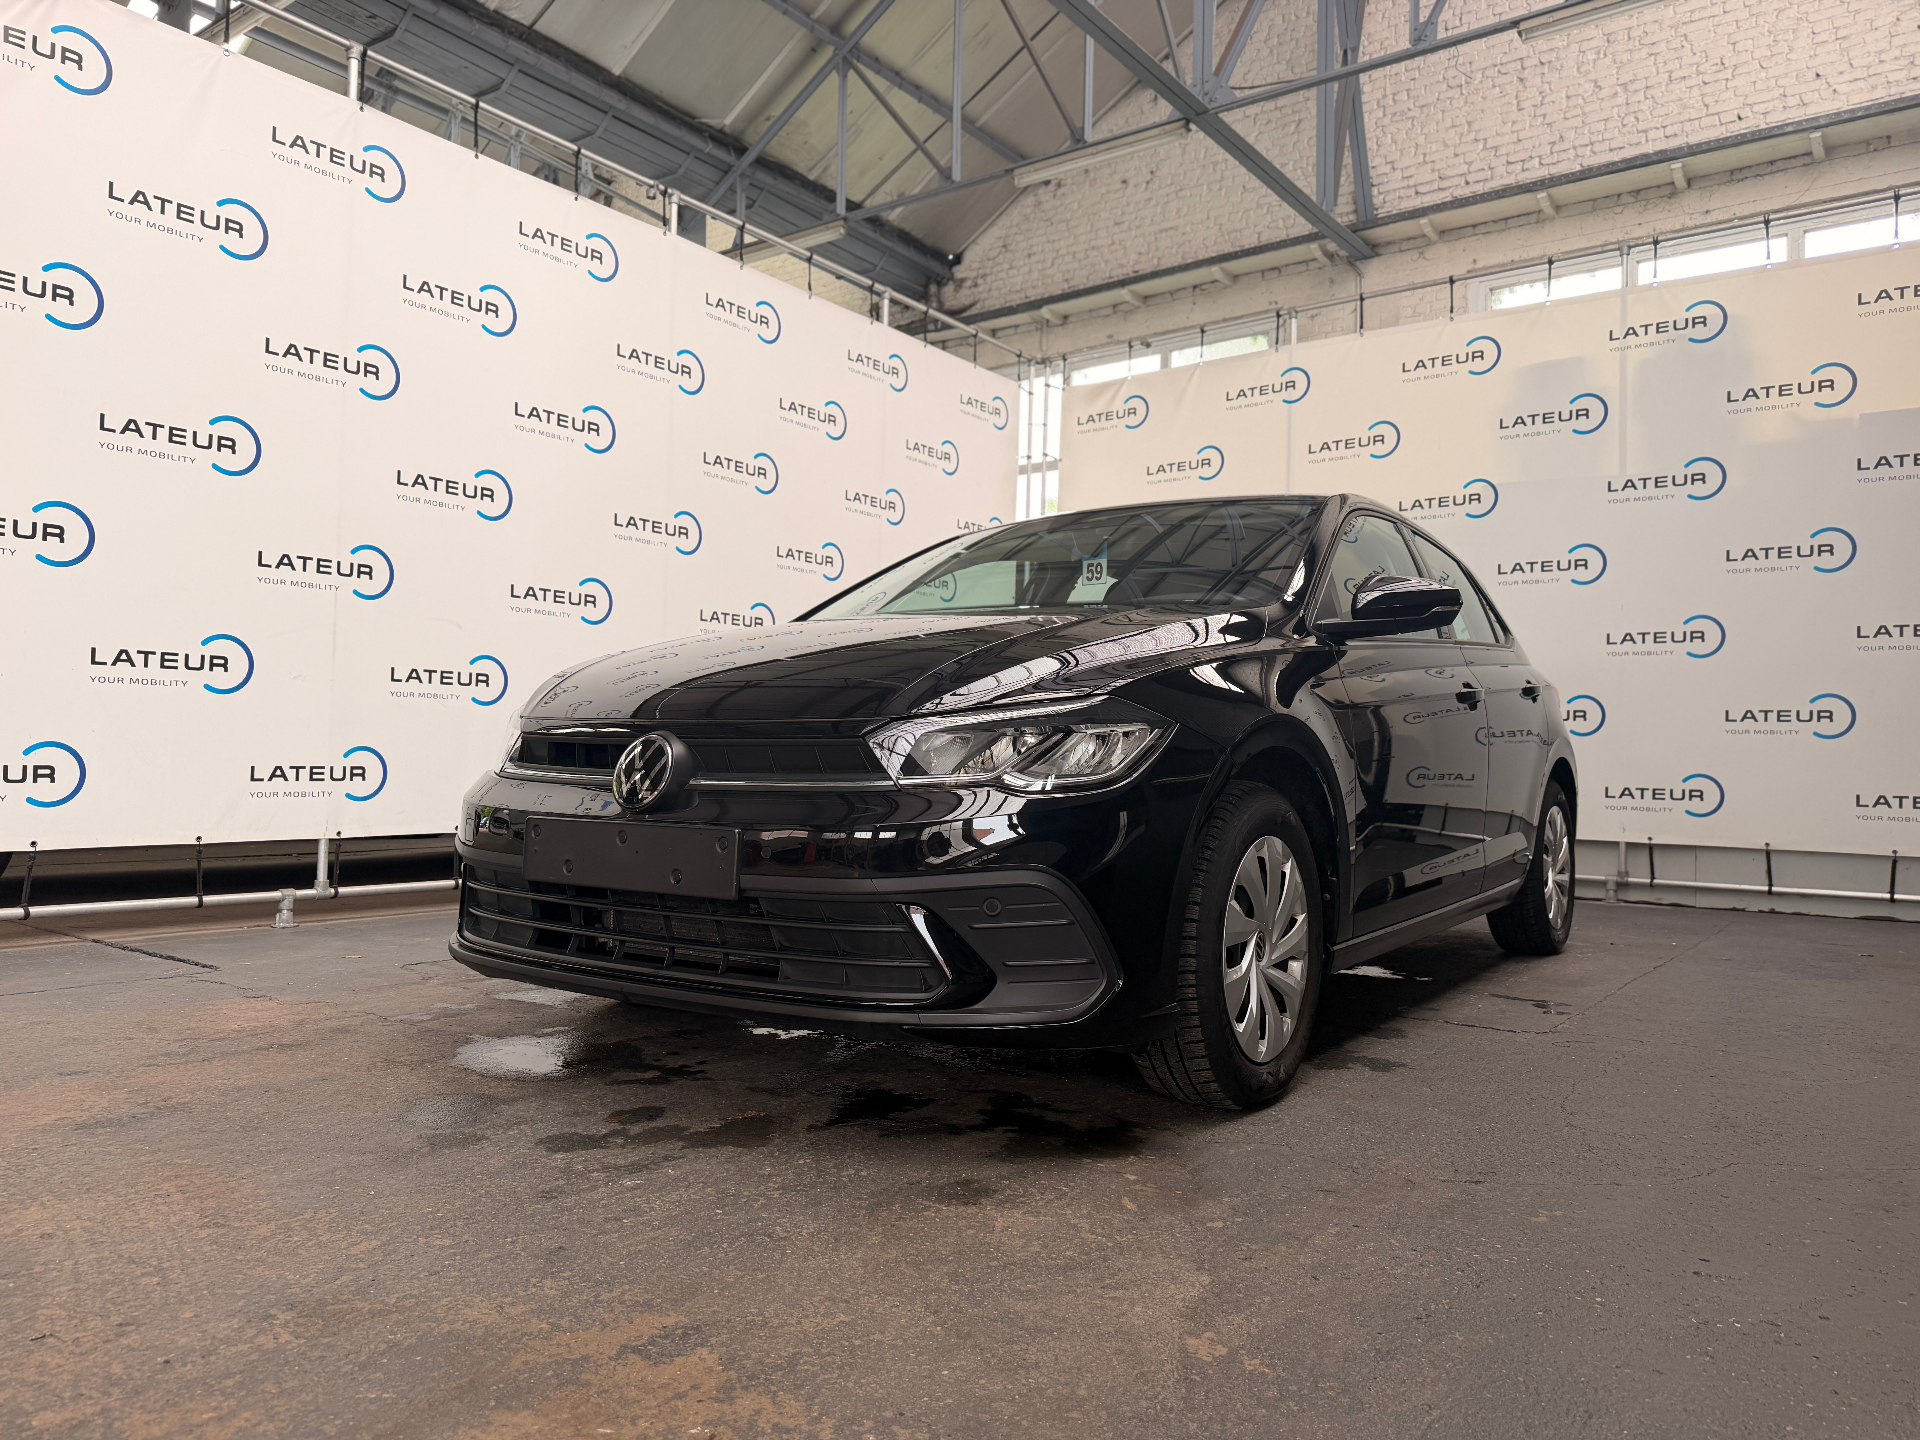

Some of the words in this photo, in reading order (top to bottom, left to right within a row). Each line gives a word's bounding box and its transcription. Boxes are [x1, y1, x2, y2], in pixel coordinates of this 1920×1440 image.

[3, 25, 83, 71] EUR
[3, 54, 35, 71] ILITY
[272, 126, 385, 183] LATEUR
[272, 152, 300, 166] YOUR
[304, 164, 352, 184] MOBILITY
[108, 181, 243, 239] LATEUR
[108, 209, 141, 225] YOUR
[147, 221, 203, 242] MOBILITY
[519, 221, 602, 265] LATEUR
[519, 243, 539, 255] YOUR
[543, 252, 578, 268] MOBILITY
[0, 270, 74, 306] EUR
[403, 274, 499, 318] LATEUR
[1858, 284, 1920, 305] LAT
[403, 298, 426, 310] YOUR
[430, 307, 470, 323] MOBILITY
[706, 293, 769, 328] LATEUR
[1858, 309, 1884, 319] YOUR
[1889, 304, 1920, 314] MOBIL
[706, 312, 721, 322] YOUR
[723, 319, 750, 332] MOBILITY
[1609, 316, 1707, 341] LATEUR
[1609, 344, 1631, 353] YOUR
[1635, 338, 1676, 348] MOBILITY
[265, 337, 379, 380] LATEUR
[617, 344, 691, 379] LATEUR
[848, 350, 899, 378] LATEUR
[1402, 350, 1484, 373] LATEUR
[265, 363, 293, 375] YOUR
[298, 371, 346, 387] MOBILITY
[617, 364, 635, 374] YOUR
[638, 371, 670, 383] MOBILITY
[1402, 376, 1421, 384] YOUR
[1424, 370, 1458, 381] MOBILITY
[1226, 380, 1295, 401] LATEUR
[1727, 379, 1834, 403] LATEUR
[780, 398, 836, 426] LATEUR
[960, 394, 1001, 418] LATEUR
[1226, 404, 1242, 412] YOUR
[1244, 399, 1274, 409] MOBILITY
[1727, 407, 1751, 415] YOUR
[1756, 401, 1801, 412] MOBILITY
[515, 402, 599, 436] LATEUR
[1078, 407, 1136, 425] LATEUR
[1500, 408, 1589, 429] LATEUR
[100, 413, 236, 454] LATEUR
[514, 424, 535, 434] YOUR
[539, 430, 574, 443] MOBILITY
[1500, 433, 1520, 441] YOUR
[1523, 428, 1561, 438] MOBILITY
[99, 442, 132, 453] YOUR
[138, 449, 196, 464] MOBILITY
[906, 439, 950, 463] LATEUR
[1309, 435, 1384, 454] LATEUR
[704, 452, 766, 479] LATEUR
[1147, 458, 1211, 475] LATEUR
[1308, 457, 1326, 465] YOUR
[1328, 453, 1360, 463] MOBILITY
[1857, 453, 1920, 471] LAT
[397, 470, 494, 502] LATEUR
[703, 470, 719, 480] YOUR
[721, 476, 748, 486] MOBILITY
[1608, 473, 1706, 492] LATEUR
[1857, 476, 1884, 484] YOUR
[1889, 473, 1920, 482] MOBIL
[397, 493, 420, 504] YOUR
[424, 499, 465, 511] MOBILITY
[846, 490, 895, 512] LATEUR
[1399, 493, 1481, 512] LATEUR
[1608, 497, 1630, 505] YOUR
[1634, 493, 1675, 503] MOBILITY
[614, 513, 688, 539] LATEUR
[957, 519, 986, 533] LATE
[1420, 512, 1455, 521] MOBILITY
[614, 533, 632, 542] YOUR
[635, 537, 667, 548] MOBILITY
[777, 546, 833, 567] LATEUR
[1726, 544, 1834, 562] LATEUR
[258, 551, 373, 580] LATEUR
[1086, 562, 1103, 581] 59
[1498, 559, 1588, 575] LATEUR
[1726, 567, 1750, 575] YOUR
[1755, 565, 1800, 573] MOBILITY
[257, 576, 286, 586] YOUR
[291, 581, 339, 591] MOBILITY
[1522, 577, 1560, 585] MOBILITY
[511, 584, 596, 608] LATEUR
[510, 605, 531, 614] YOUR
[535, 608, 570, 619] MOBILITY
[700, 609, 764, 627] LATEUR
[1607, 631, 1705, 645] LATEUR
[1857, 624, 1920, 638] LAT
[91, 647, 228, 672] LATEUR
[90, 675, 124, 685] YOUR
[130, 677, 188, 688] MOBILITY
[391, 667, 489, 687] LATEUR
[390, 690, 414, 699] YOUR
[418, 692, 460, 701] MOBILITY
[1725, 710, 1833, 722] LATEUR
[250, 766, 366, 781] LATEUR
[250, 791, 278, 799] YOUR
[283, 790, 332, 798] MOBILITY
[1605, 787, 1703, 801] LATEUR
[1856, 795, 1920, 809] LAT
[1631, 805, 1673, 813] MOBILITY
[1856, 814, 1883, 822] YOUR
